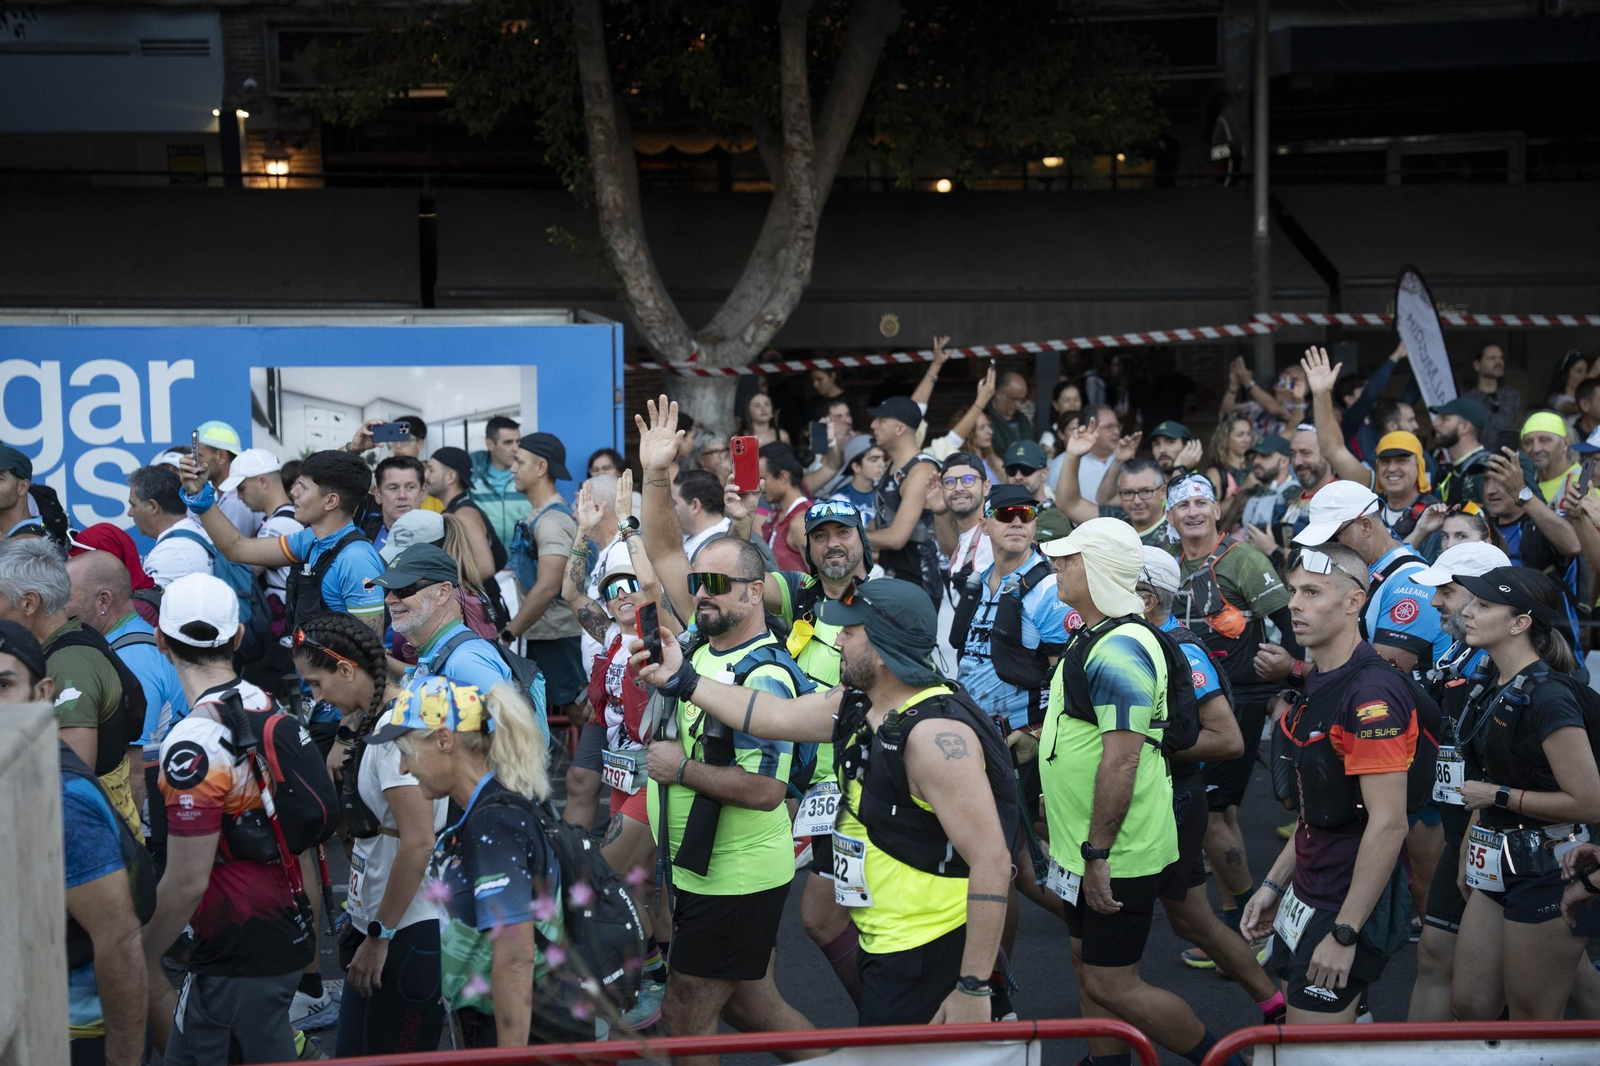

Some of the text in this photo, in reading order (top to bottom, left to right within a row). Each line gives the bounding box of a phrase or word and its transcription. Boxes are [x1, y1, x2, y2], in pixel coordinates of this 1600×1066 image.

[0, 358, 195, 476] gar
[603, 766, 627, 789] 2797
[808, 796, 839, 817] 356
[1303, 989, 1336, 1003] NIKE TRAI
